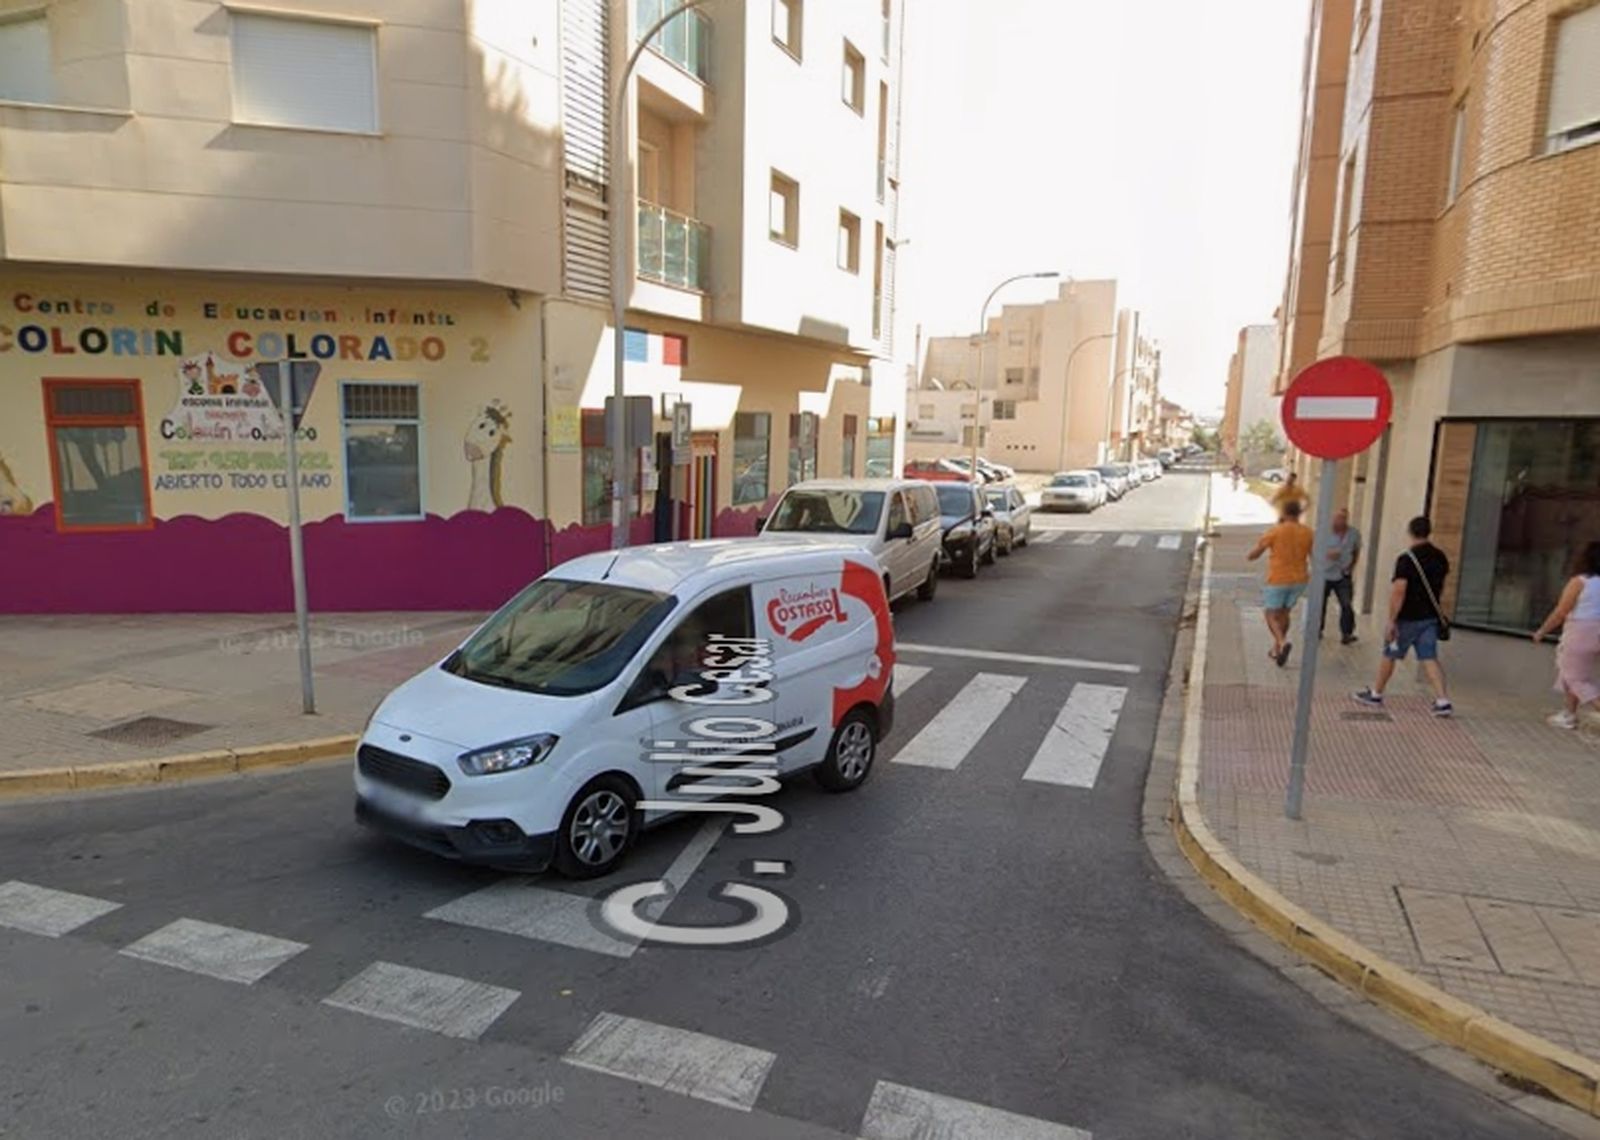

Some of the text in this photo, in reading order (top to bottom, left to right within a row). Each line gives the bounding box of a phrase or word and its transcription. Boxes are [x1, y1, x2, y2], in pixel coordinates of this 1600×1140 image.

[14, 293, 115, 315] Centro
[146, 301, 176, 317] de
[228, 332, 446, 361] COLORADO
[470, 337, 489, 361] 2
[155, 474, 222, 490] ABIERTO
[228, 473, 266, 488] TODO
[767, 588, 847, 636] COSTASOL
